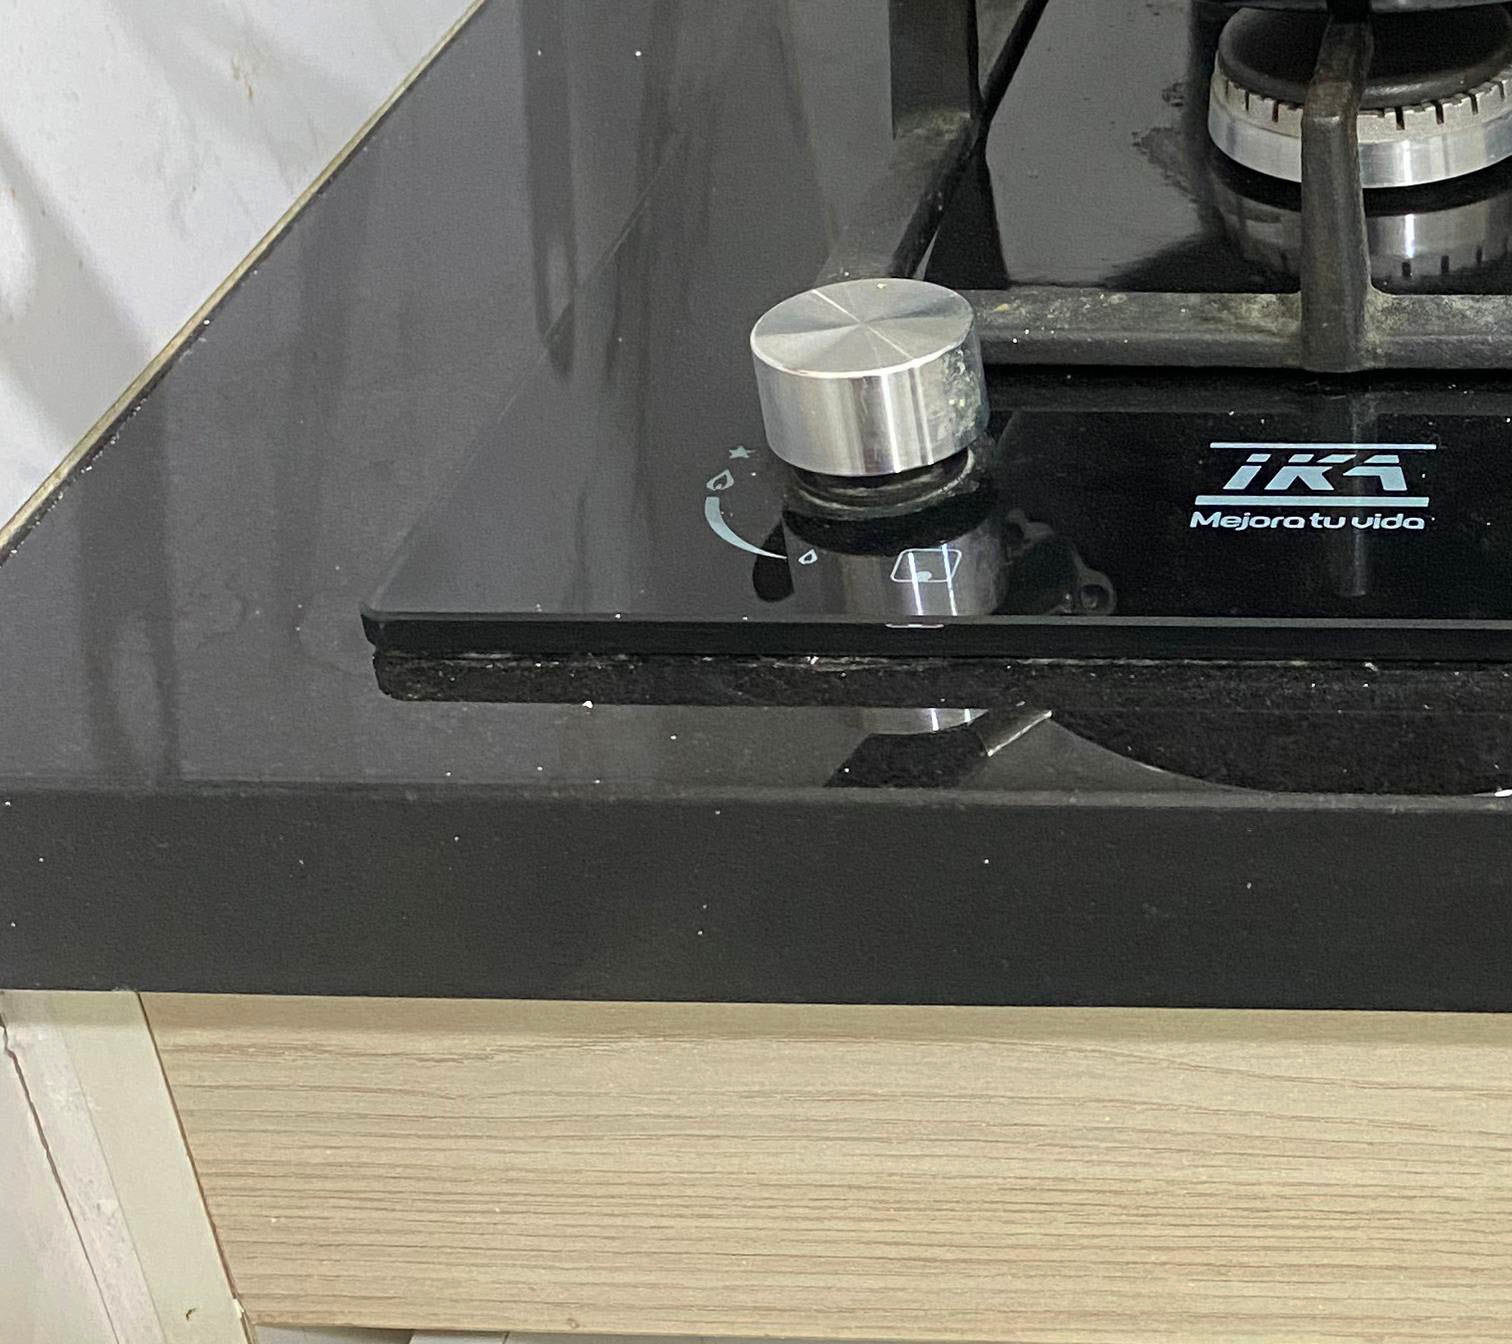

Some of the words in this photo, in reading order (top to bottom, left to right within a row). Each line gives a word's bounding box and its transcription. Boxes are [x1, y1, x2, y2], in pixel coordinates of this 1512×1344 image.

[1189, 511, 1306, 531] Mejora
[1309, 512, 1346, 530] tu
[1351, 512, 1425, 530] vida
